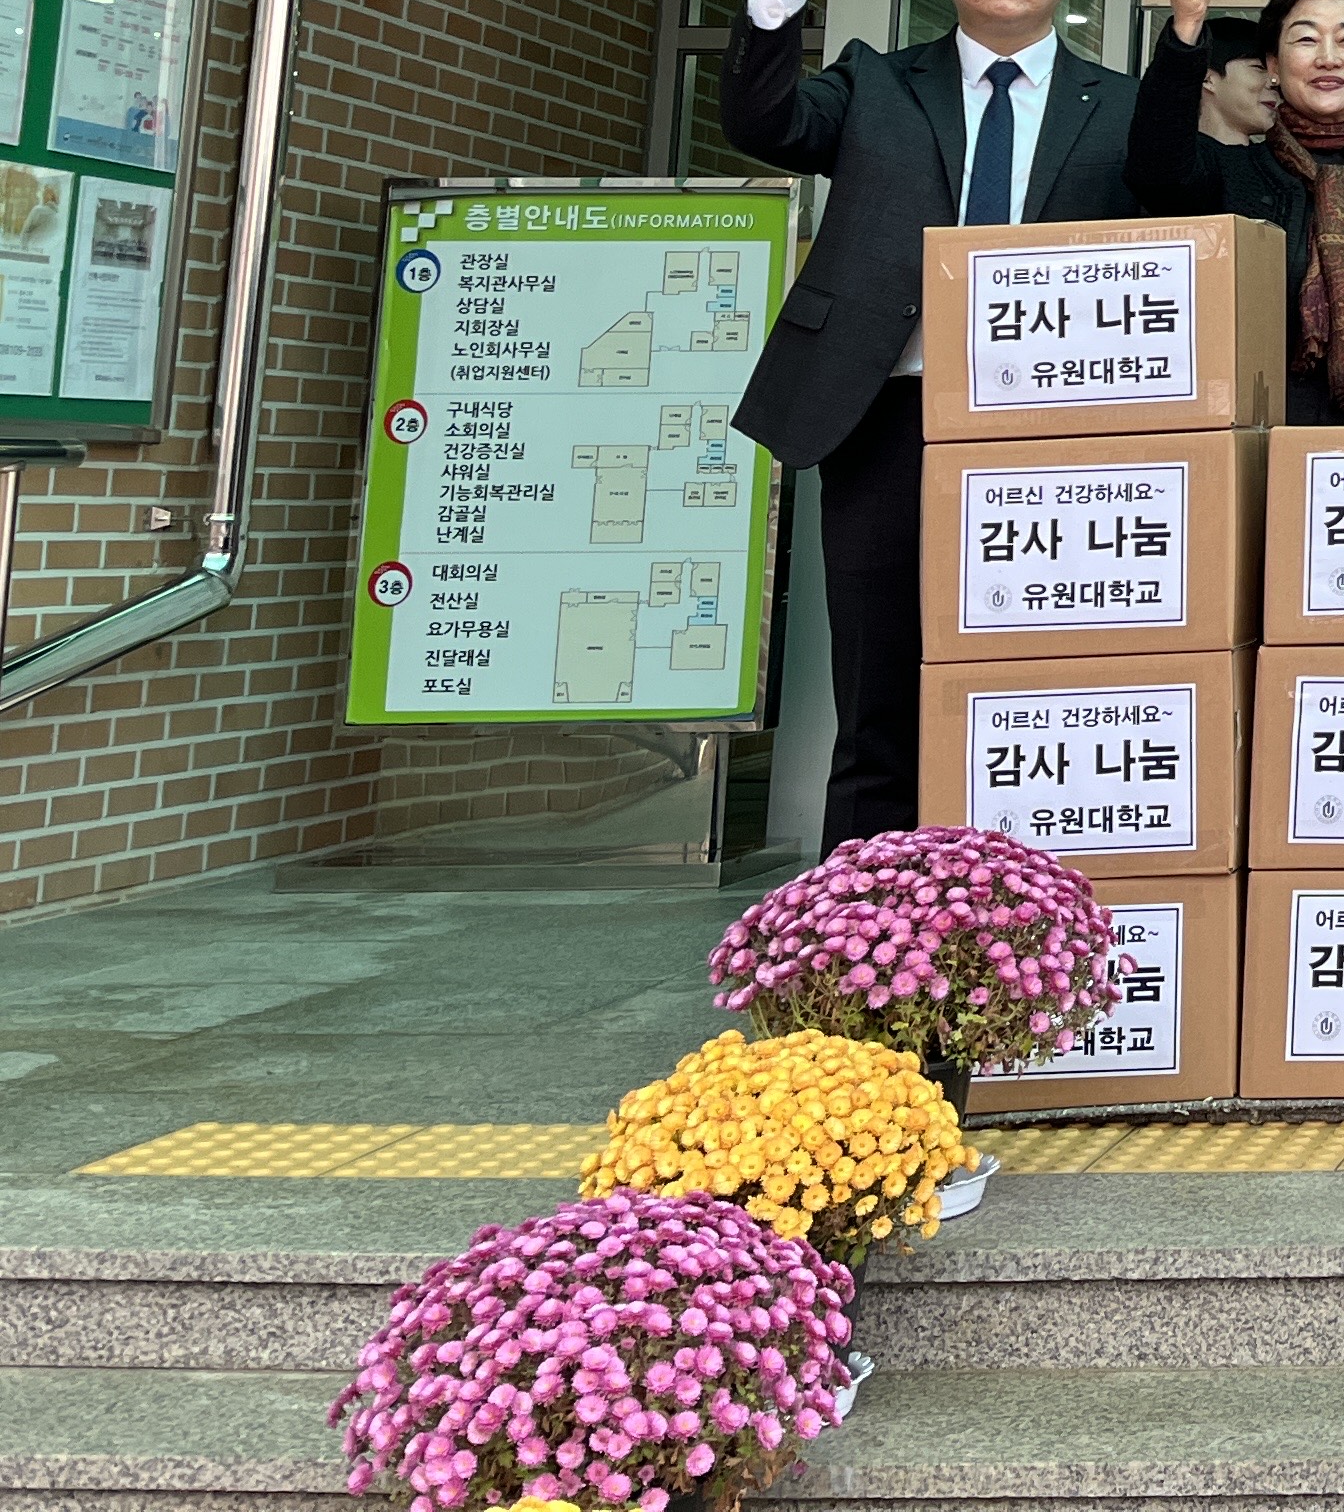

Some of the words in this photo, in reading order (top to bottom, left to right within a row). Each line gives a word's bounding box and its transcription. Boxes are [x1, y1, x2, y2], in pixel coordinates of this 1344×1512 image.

[460, 253, 509, 271] 관장실
[409, 266, 432, 282] 1층
[992, 268, 1050, 288] 어르신
[1062, 261, 1172, 284] 건강하세요~
[457, 275, 556, 293] 복지관사무실
[456, 297, 505, 315] 상담실
[987, 297, 1071, 342] 감사
[1096, 293, 1180, 336] 나눔
[454, 319, 519, 337] 지회장실
[451, 341, 551, 360] 노인회사무실
[450, 364, 551, 381] (취업지원센터)
[1030, 356, 1172, 388] 유원대학교
[447, 401, 513, 419] 구내식당
[395, 416, 420, 433] 2층
[444, 422, 510, 440] 소회의실
[443, 442, 525, 460] 건강증진실
[440, 463, 490, 481] 샤워실
[439, 483, 555, 502] 기능회복관리실
[985, 485, 1043, 507] 어르신
[1055, 482, 1165, 505] 건강하세요~
[437, 504, 487, 523] 감골실
[436, 525, 485, 544] 난계실
[979, 518, 1063, 563] 감사
[1088, 515, 1172, 558] 나눔
[432, 563, 498, 582] 대회의실
[378, 579, 404, 595] 3층
[1021, 579, 1162, 611] 유원대학교
[429, 592, 479, 611] 전산실
[425, 620, 510, 639] 요가무용실
[424, 649, 491, 668] 진달래실
[421, 677, 472, 696] 포도실
[992, 708, 1050, 731] 어르신
[1061, 704, 1173, 728] 건강하세요~
[985, 742, 1070, 788] 감사
[1095, 738, 1180, 783] 나눔
[1029, 804, 1172, 837] 유원대학교
